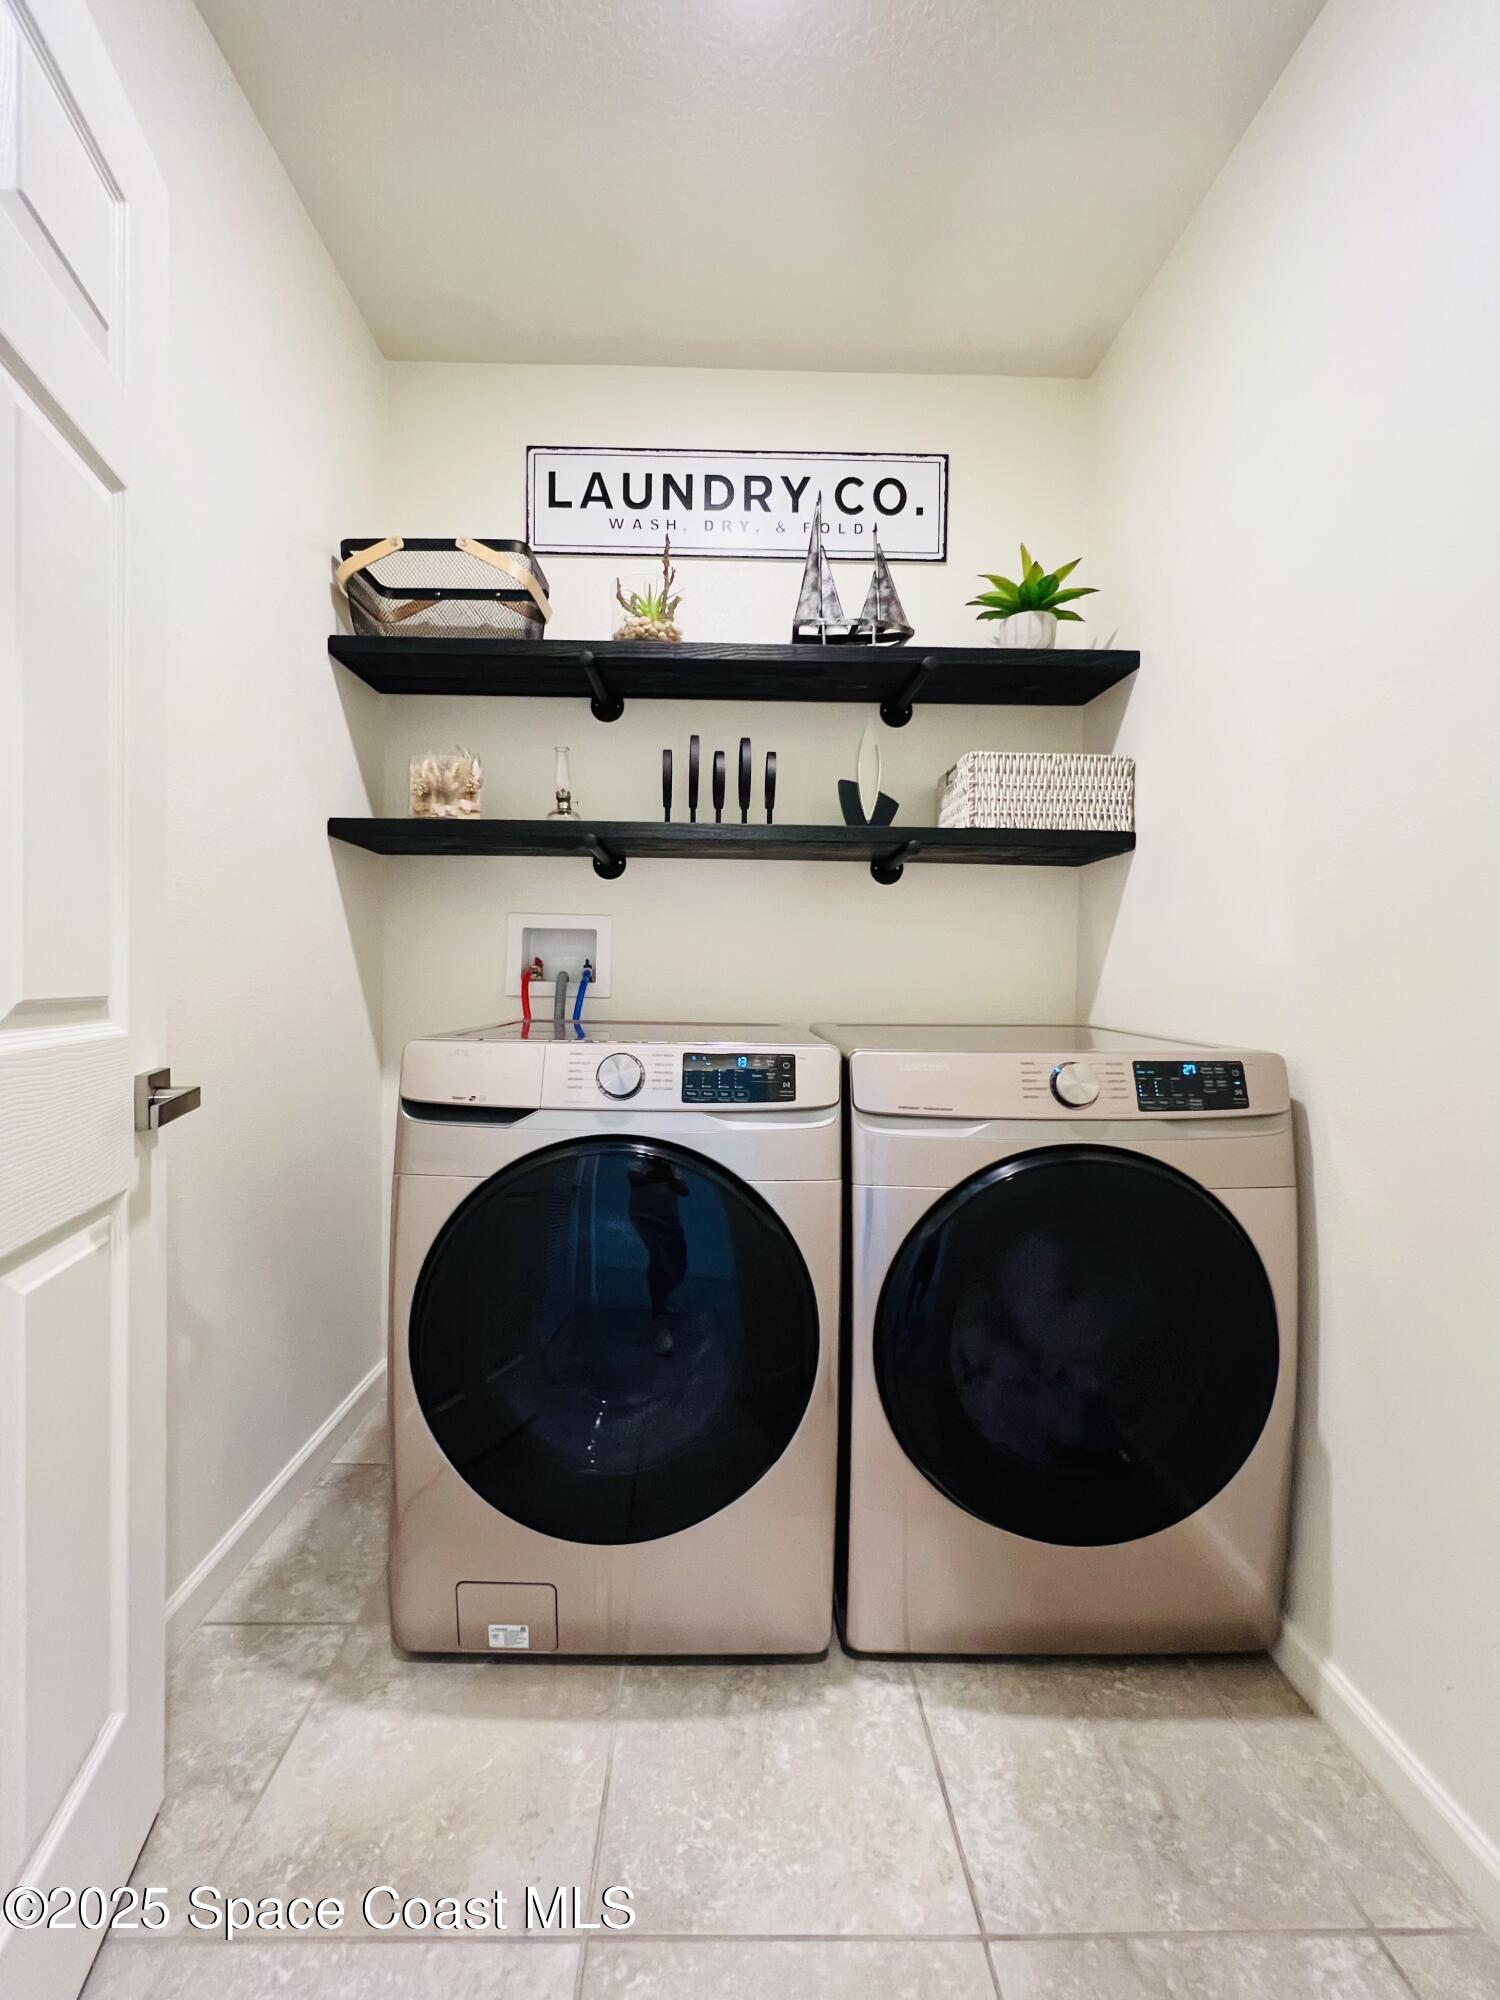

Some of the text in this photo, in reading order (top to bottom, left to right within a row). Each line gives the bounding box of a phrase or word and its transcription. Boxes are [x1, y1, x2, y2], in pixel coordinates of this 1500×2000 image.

[547, 470, 924, 517] LAUNDRY CO.
[608, 517, 687, 532] WASH,
[775, 521, 786, 534] &
[802, 522, 864, 535] FOLD
